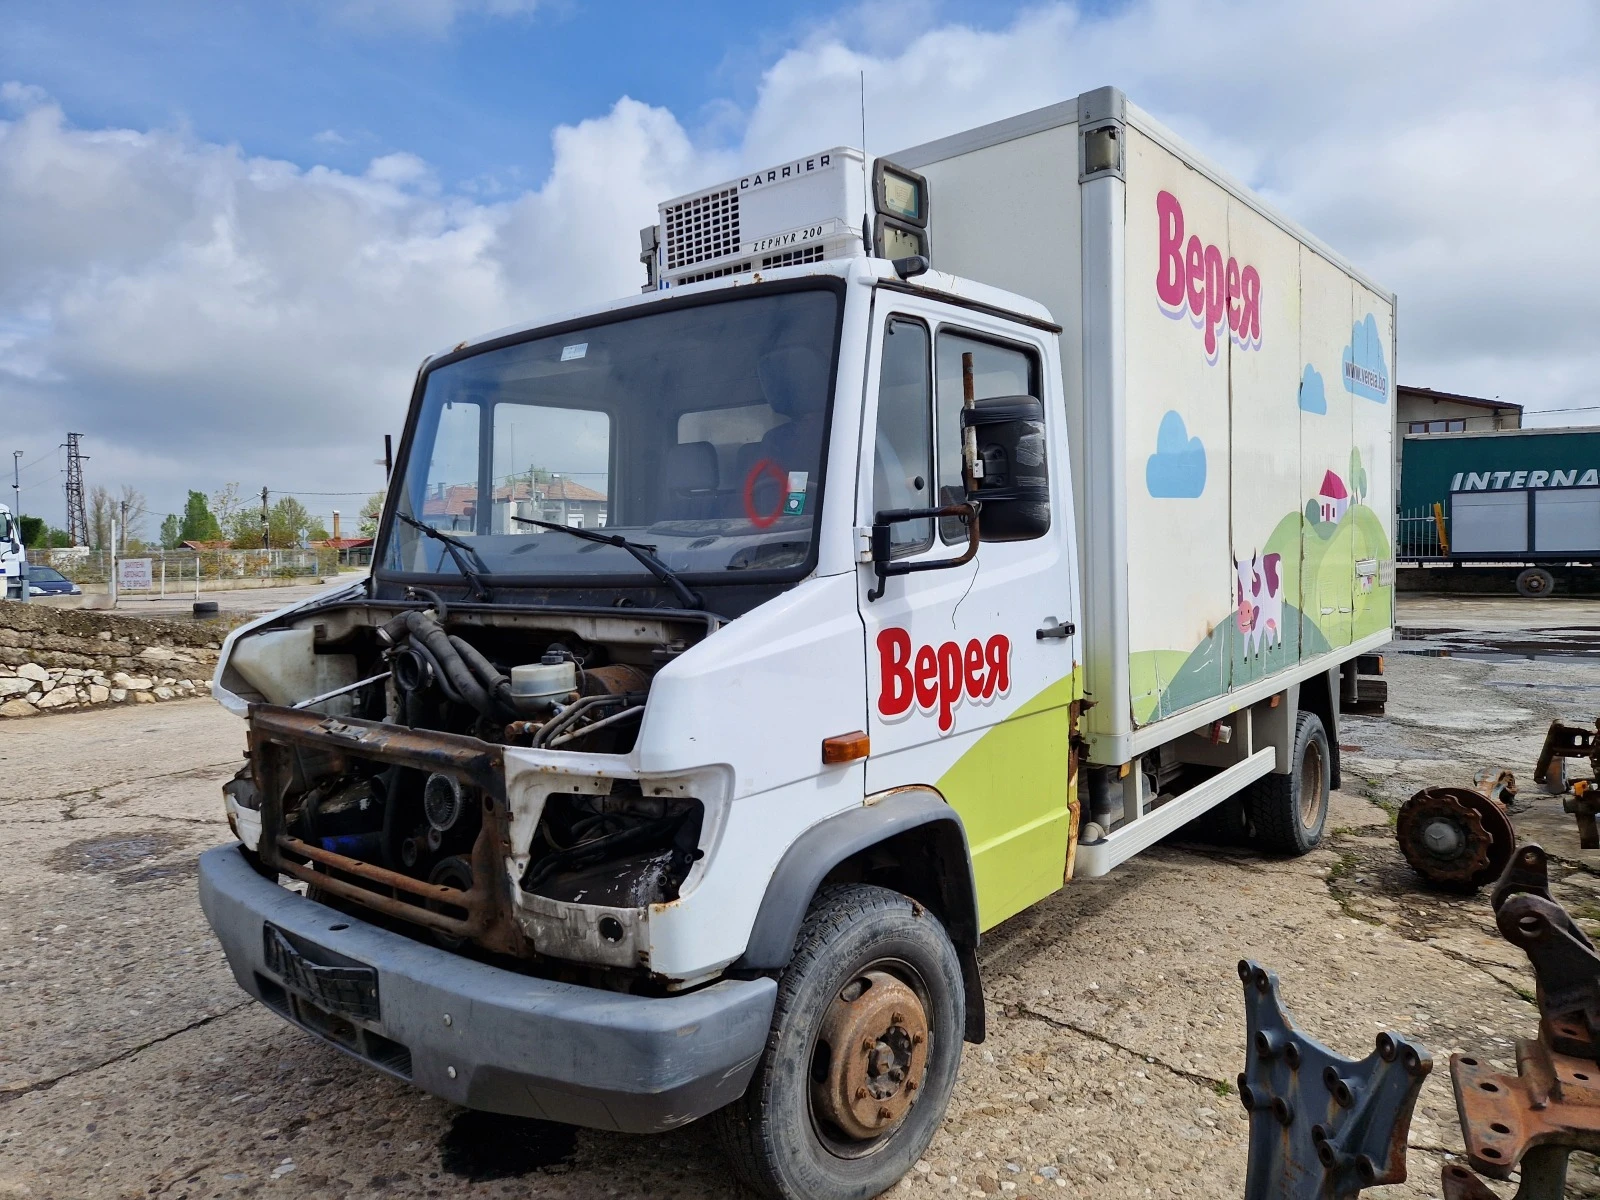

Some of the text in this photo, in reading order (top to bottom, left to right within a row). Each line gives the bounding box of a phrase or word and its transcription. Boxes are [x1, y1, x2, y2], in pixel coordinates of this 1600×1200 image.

[740, 154, 830, 190] CARRIER
[753, 225, 823, 252] ZEPHYR 200
[1156, 190, 1262, 356] Верея
[1344, 361, 1386, 396] www.vereia.bg
[1450, 468, 1600, 491] INTERNA
[876, 627, 1011, 732] Верея
